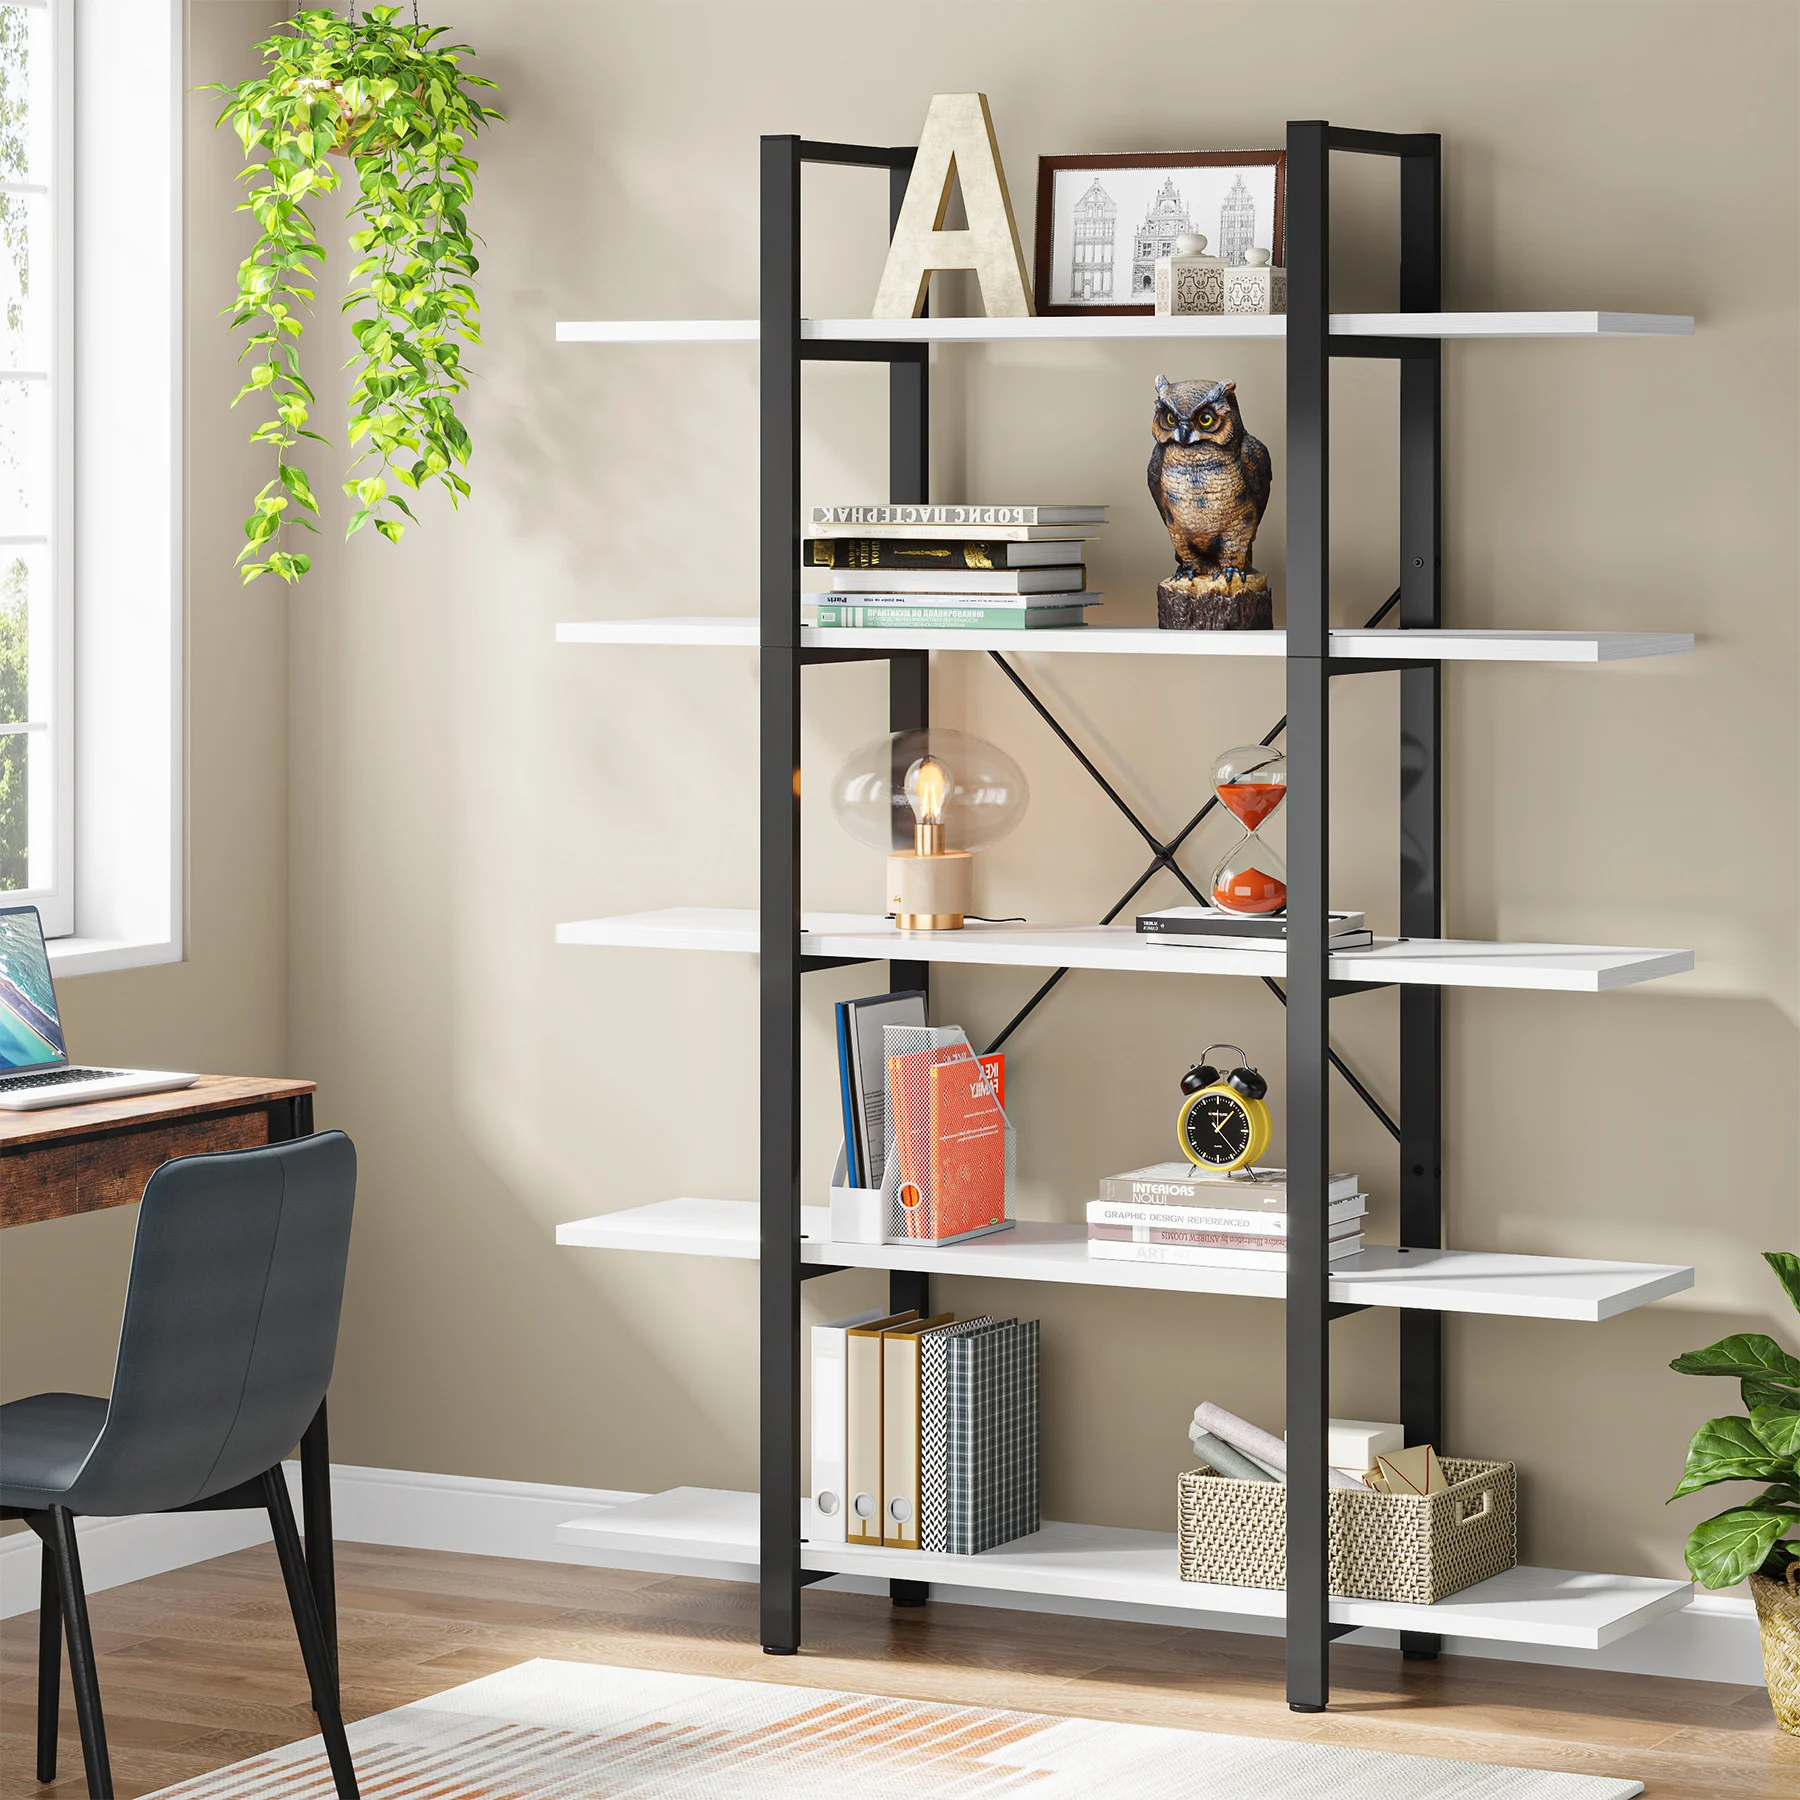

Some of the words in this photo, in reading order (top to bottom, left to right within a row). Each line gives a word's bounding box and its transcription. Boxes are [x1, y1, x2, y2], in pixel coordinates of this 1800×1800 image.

[872, 93, 1036, 318] A
[820, 507, 946, 523] ПАСТЕРНАК
[954, 508, 1024, 523] БОРИС
[1132, 1182, 1195, 1197] INTERIORS
[1132, 1193, 1167, 1205] NOW!
[1104, 1210, 1147, 1221] GRAPHIC
[1149, 1213, 1184, 1223] DESIGN
[1187, 1216, 1250, 1227] REFERENCED
[1161, 1231, 1188, 1242] LOOMIS
[1189, 1232, 1220, 1243] ANDREW
[1220, 1234, 1229, 1245] by
[1229, 1235, 1263, 1247] Illustration
[1136, 1246, 1167, 1260] ART
